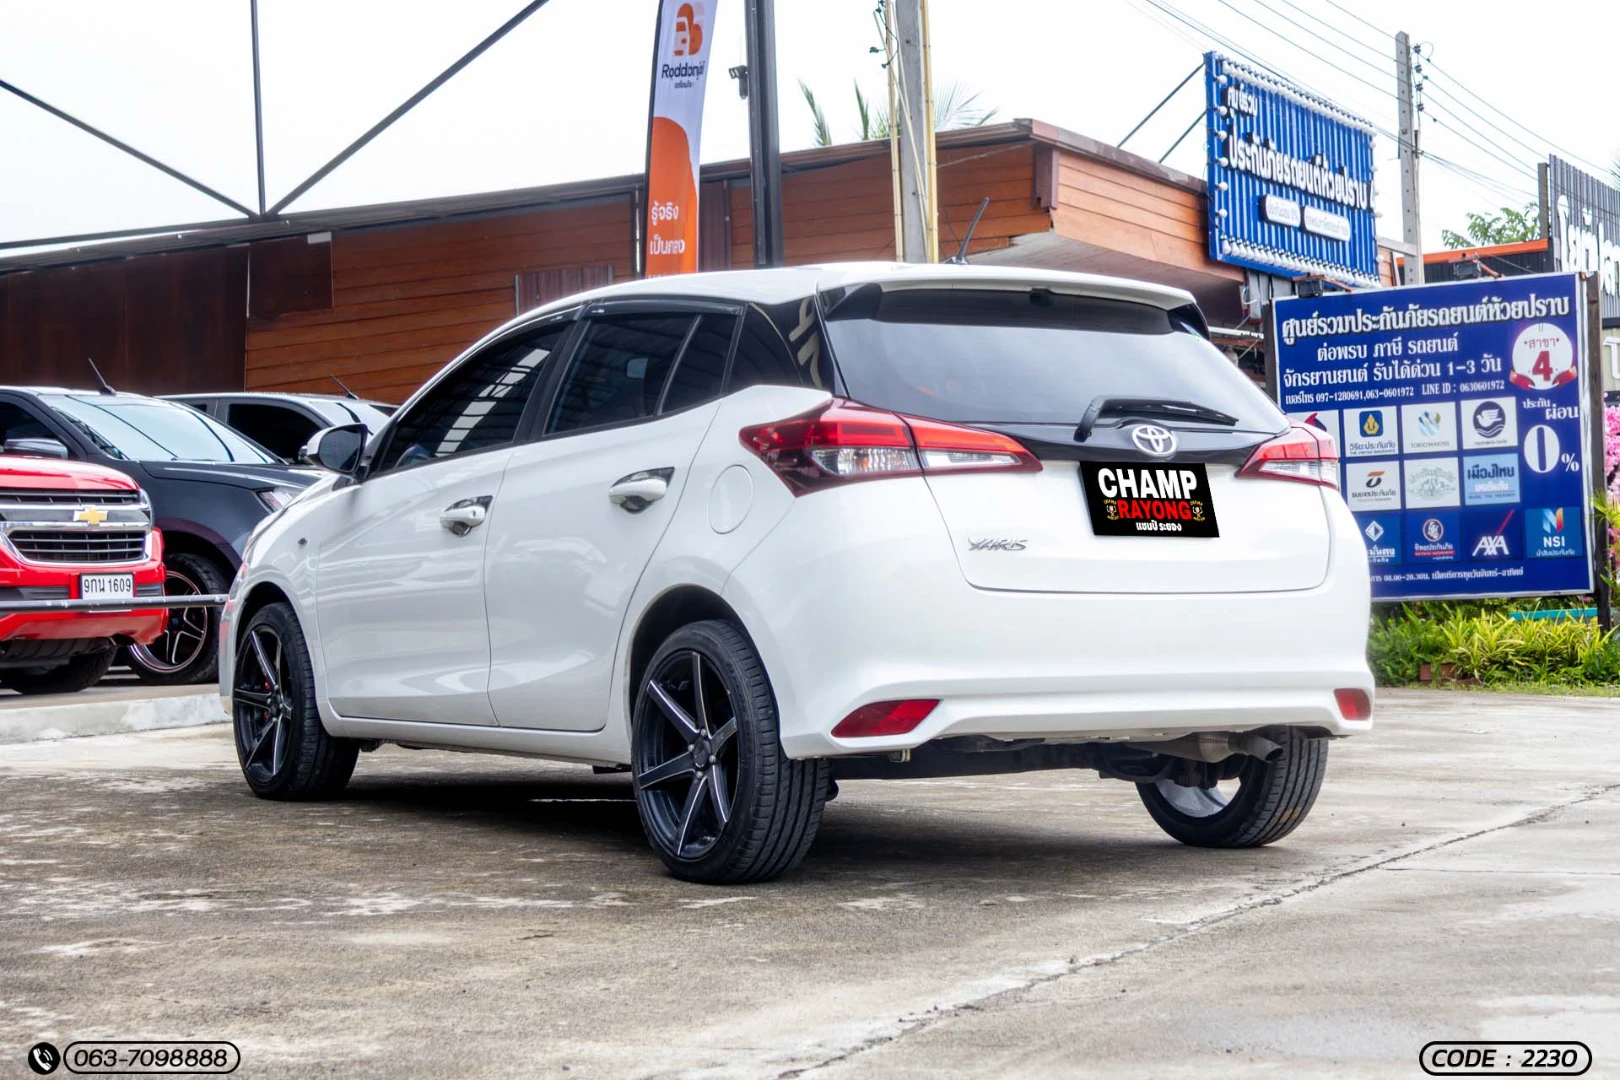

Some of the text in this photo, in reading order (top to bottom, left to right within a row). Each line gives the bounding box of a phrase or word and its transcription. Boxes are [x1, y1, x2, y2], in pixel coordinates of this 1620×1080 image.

[1282, 294, 1569, 346] ศูนย์รวมประกันภัยรถยนต์ห้วยปราบ
[1317, 332, 1458, 361] ต่อพรบ ภาษี รถยนต์
[1283, 354, 1502, 387] จักรยานยนต์ รับได้ด่วน 1-3 วัน
[1532, 350, 1556, 381] 4
[1422, 383, 1440, 395] LINE
[1523, 397, 1551, 409] ประกัน
[1545, 403, 1580, 420] ผ่อน
[968, 537, 1028, 551] YARIS
[1472, 535, 1510, 556] AXA
[1543, 536, 1566, 547] NSI
[108, 578, 131, 593] 1609
